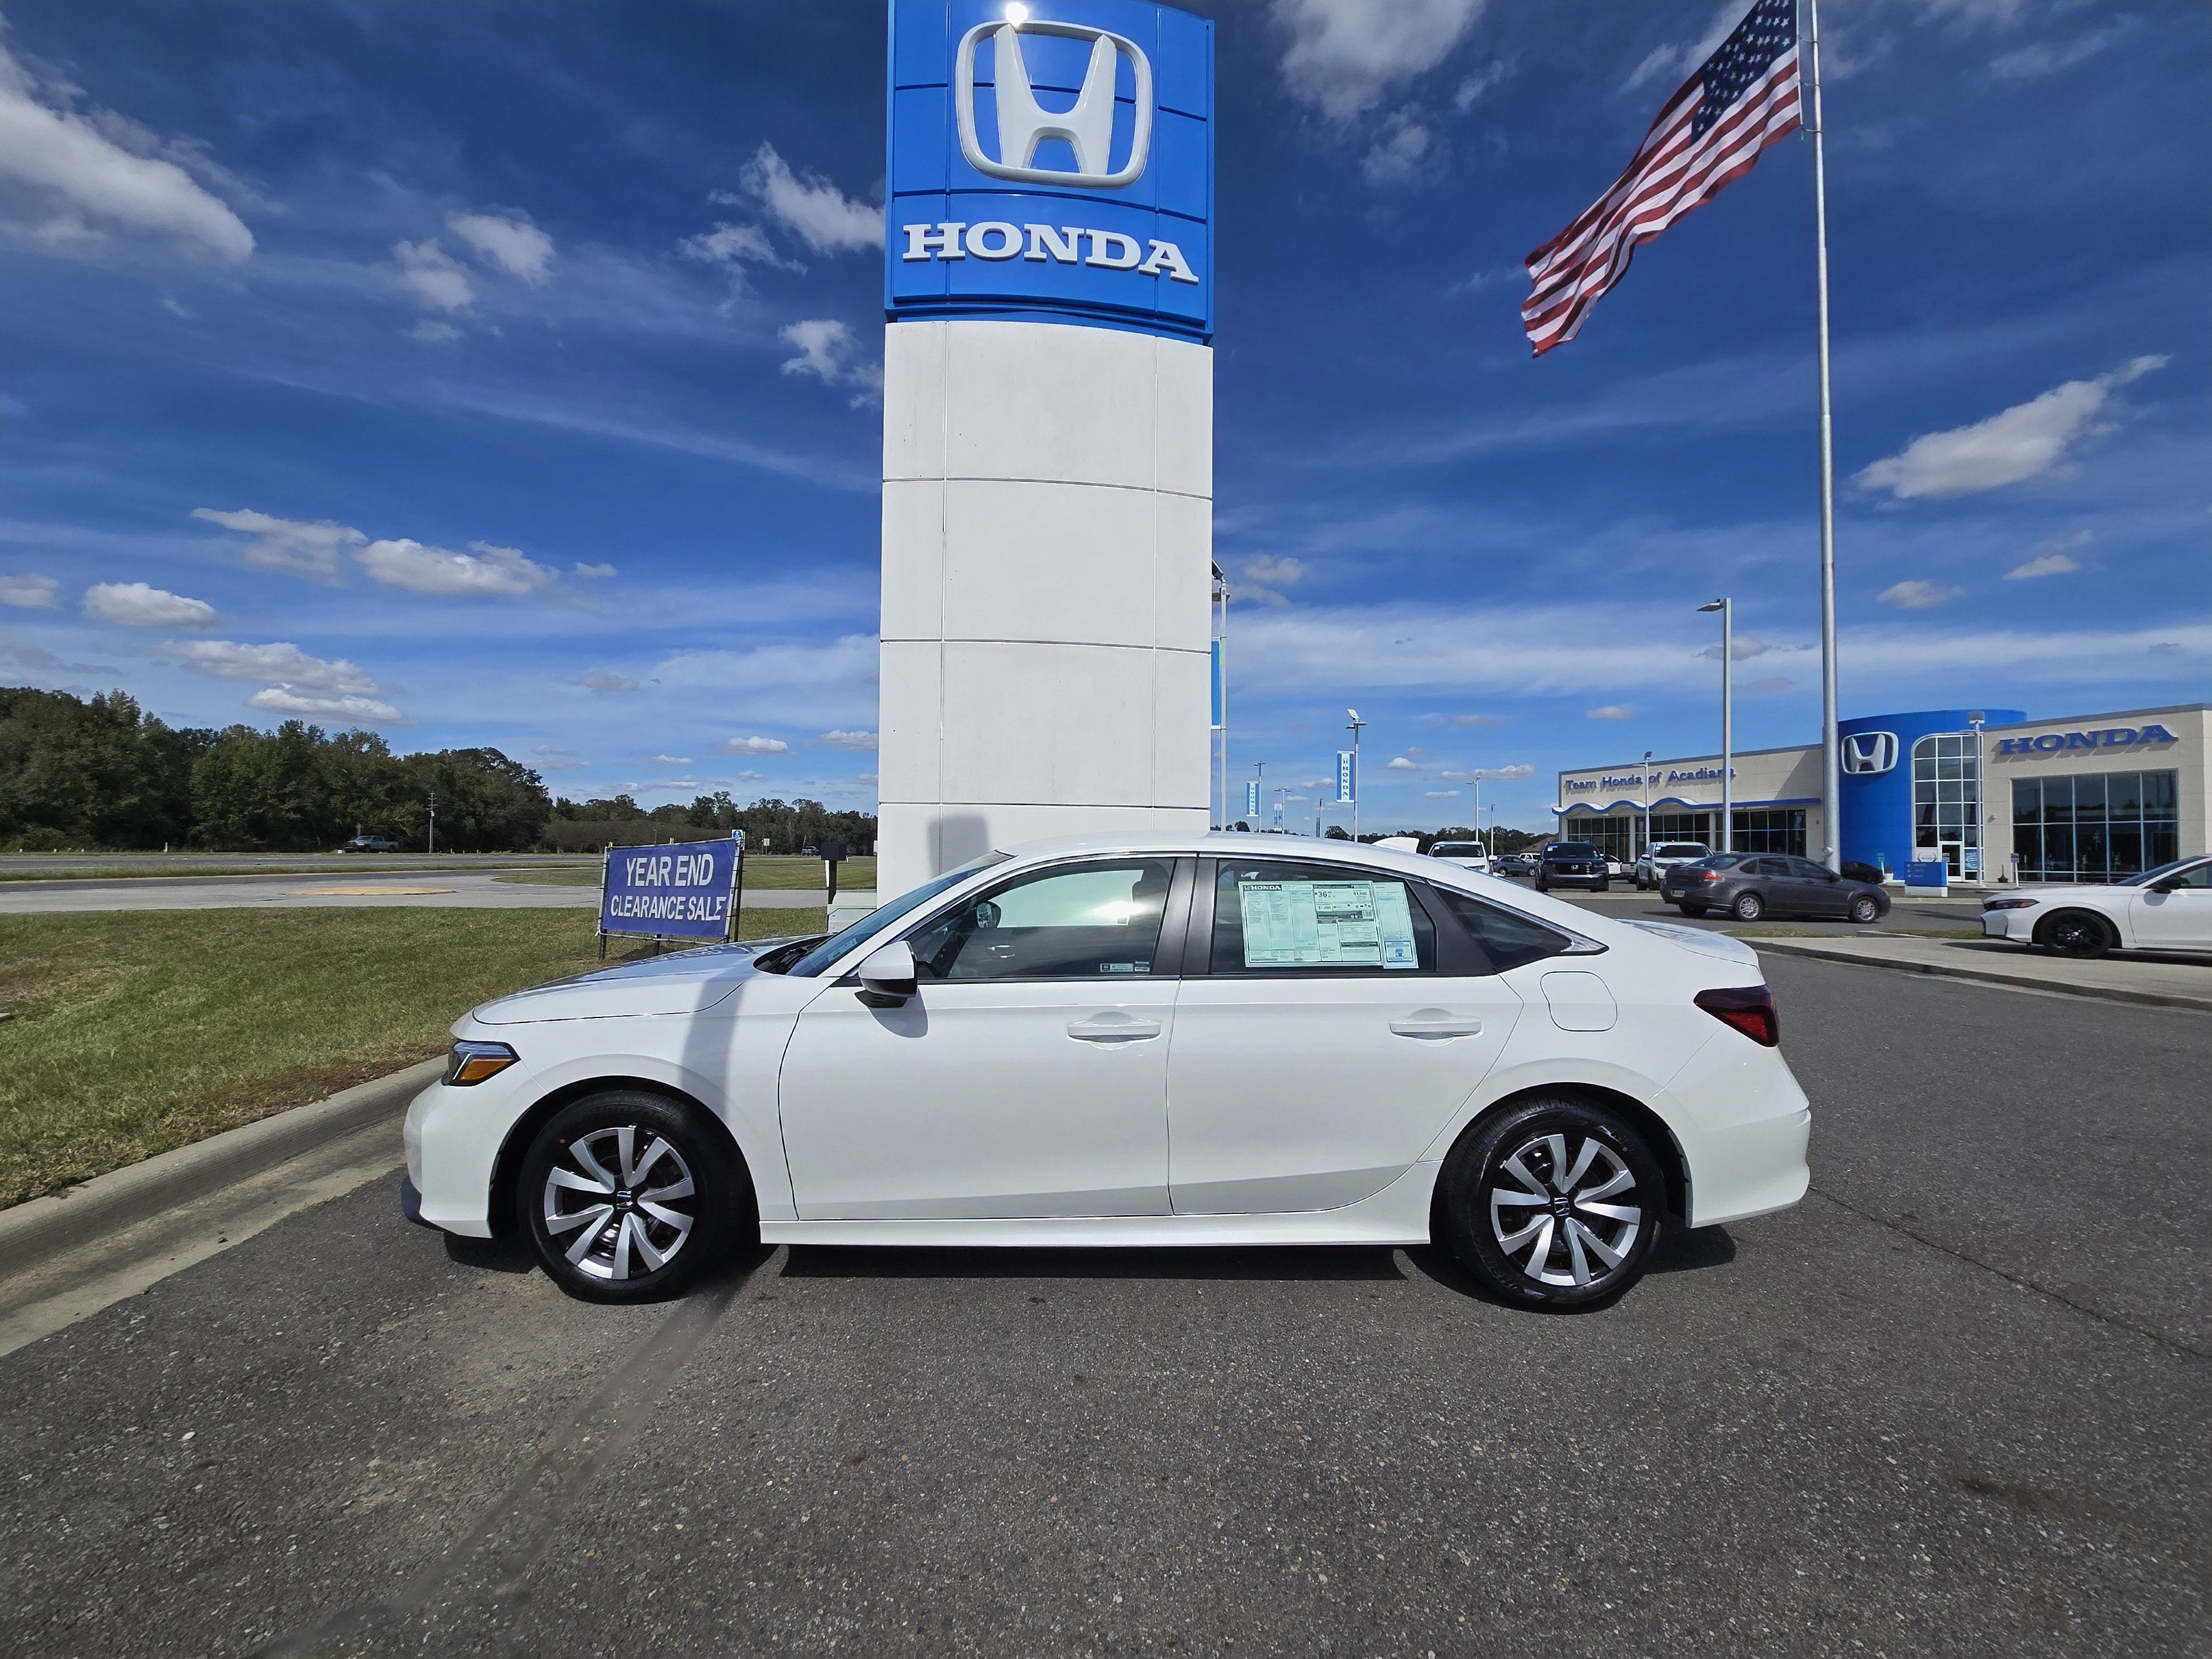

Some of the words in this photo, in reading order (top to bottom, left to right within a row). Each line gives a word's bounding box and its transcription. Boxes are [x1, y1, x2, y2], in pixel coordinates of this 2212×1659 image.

[902, 221, 1199, 285] HONDA
[1999, 724, 2179, 755] HONDA
[1565, 780, 1597, 790] Team
[1602, 774, 1642, 787] Honda
[1648, 771, 1663, 783] of
[627, 856, 672, 886] YEAR
[675, 853, 714, 886] END
[611, 895, 686, 920] CLEARANCE
[687, 896, 727, 921] SALE
